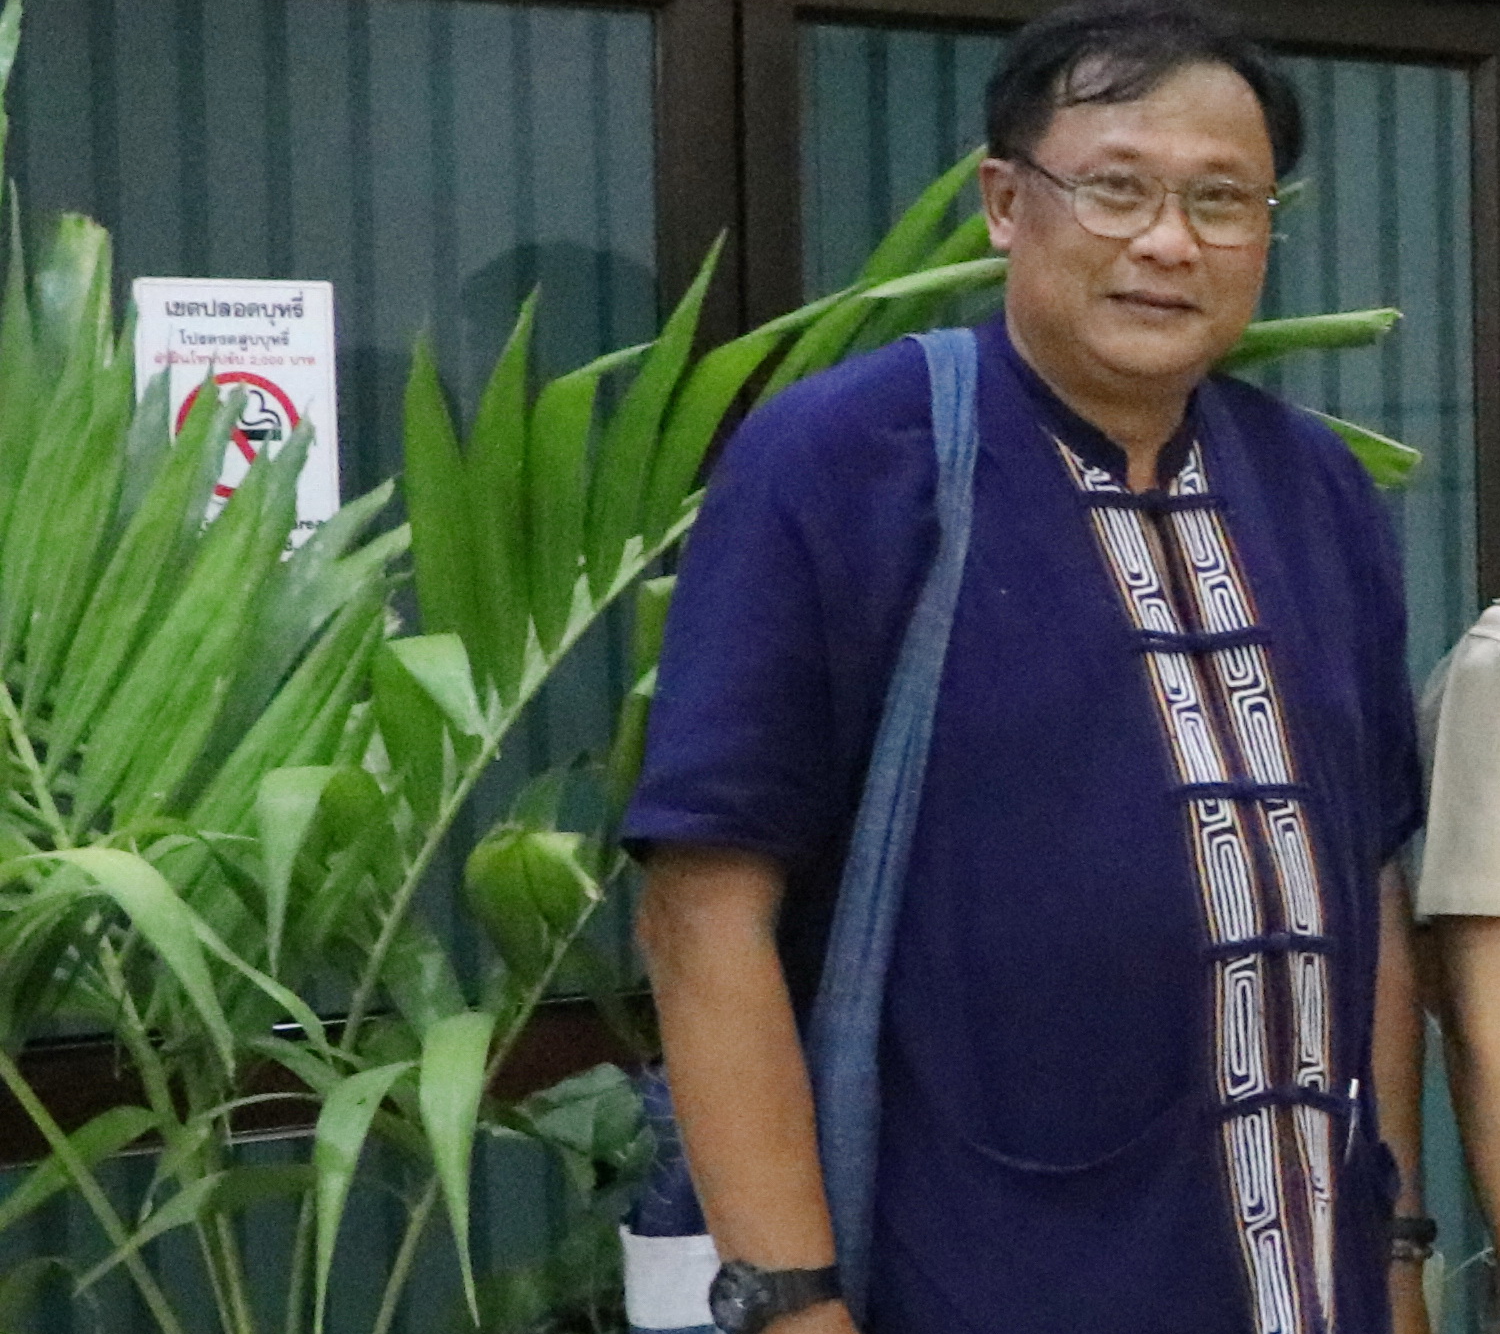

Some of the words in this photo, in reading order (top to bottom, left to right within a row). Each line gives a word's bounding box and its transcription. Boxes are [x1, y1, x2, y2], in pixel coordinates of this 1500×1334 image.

[165, 291, 304, 326] เขตปลอดบุหรี่
